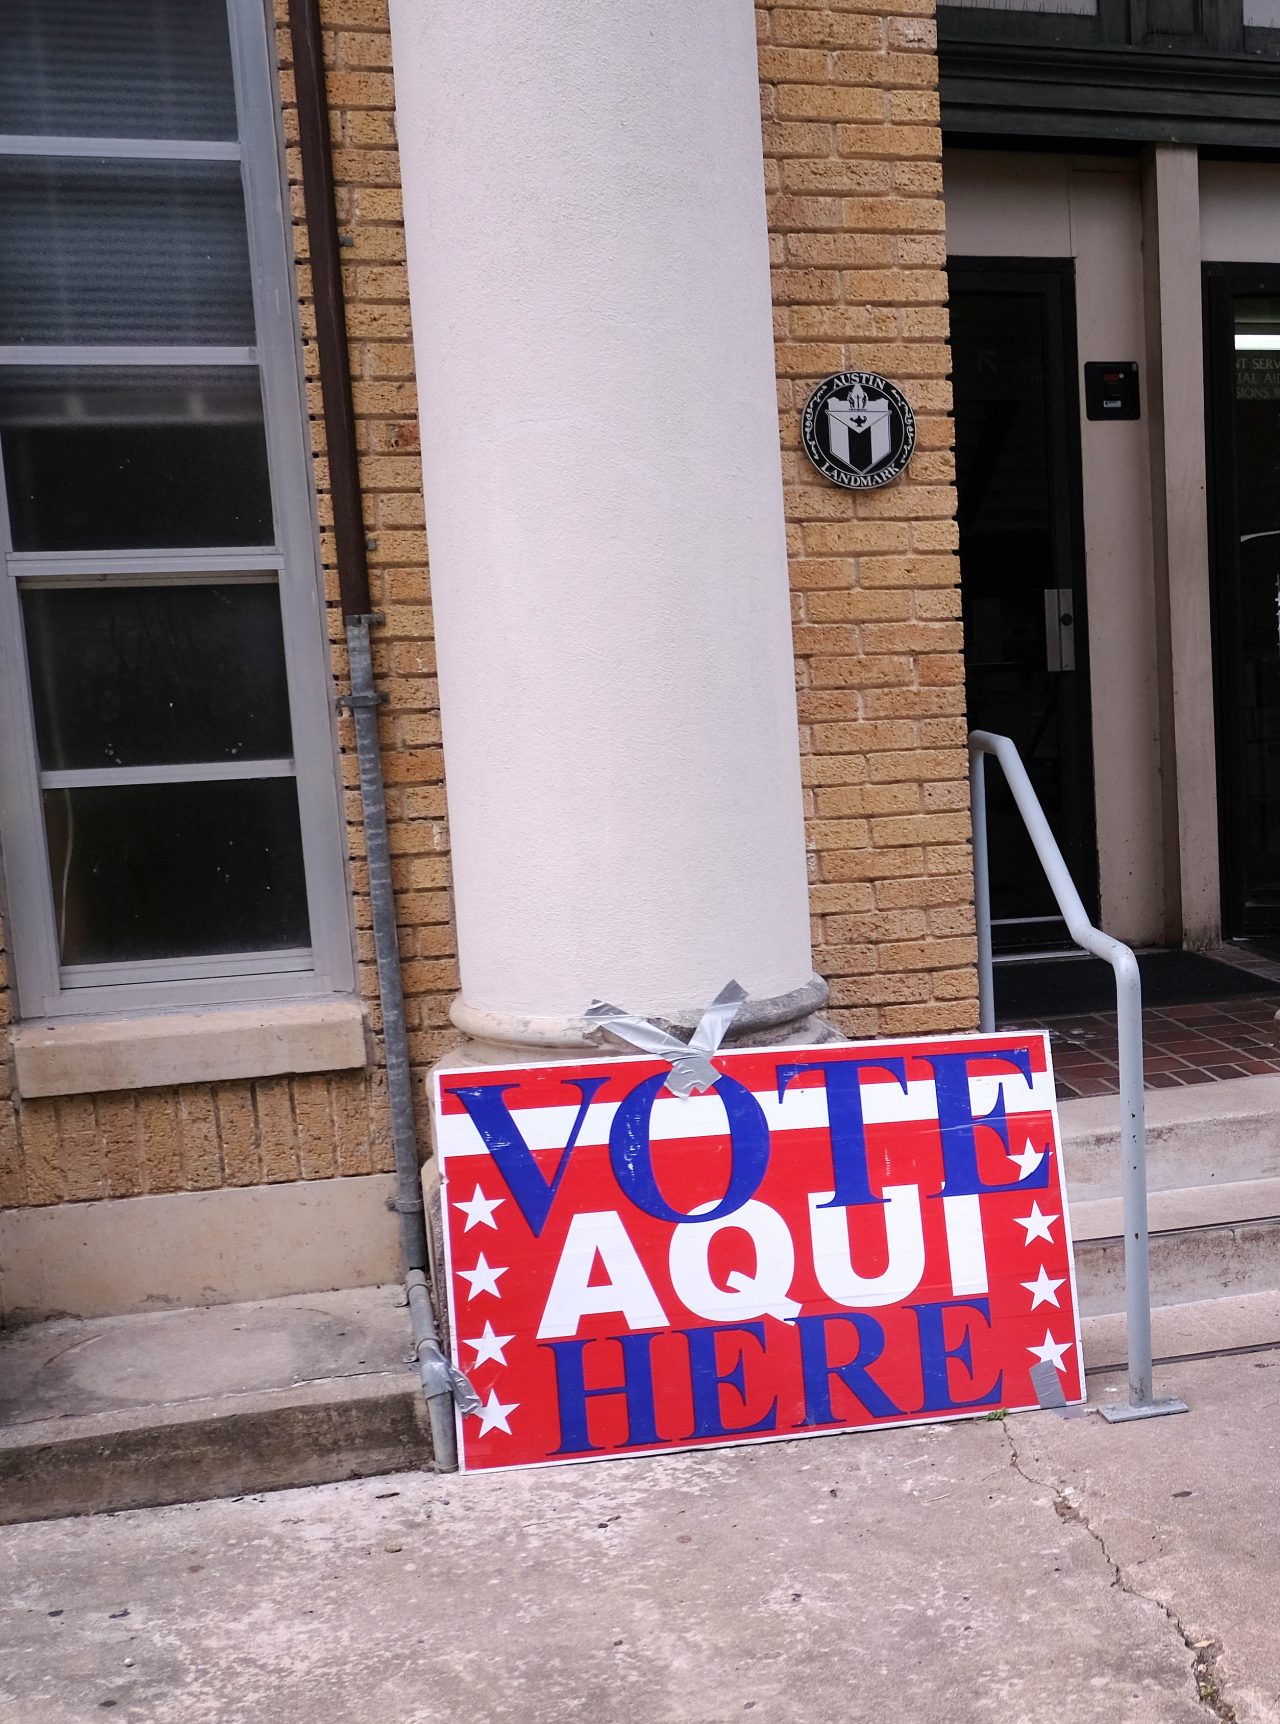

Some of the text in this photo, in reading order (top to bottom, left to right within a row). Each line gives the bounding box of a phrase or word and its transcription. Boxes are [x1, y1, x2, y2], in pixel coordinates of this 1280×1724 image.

[833, 373, 886, 390] AUSTIN
[821, 463, 900, 487] LANDMARK
[444, 1049, 1052, 1238] VOTE
[536, 1182, 990, 1339] AQUI
[537, 1297, 1004, 1456] HERE
